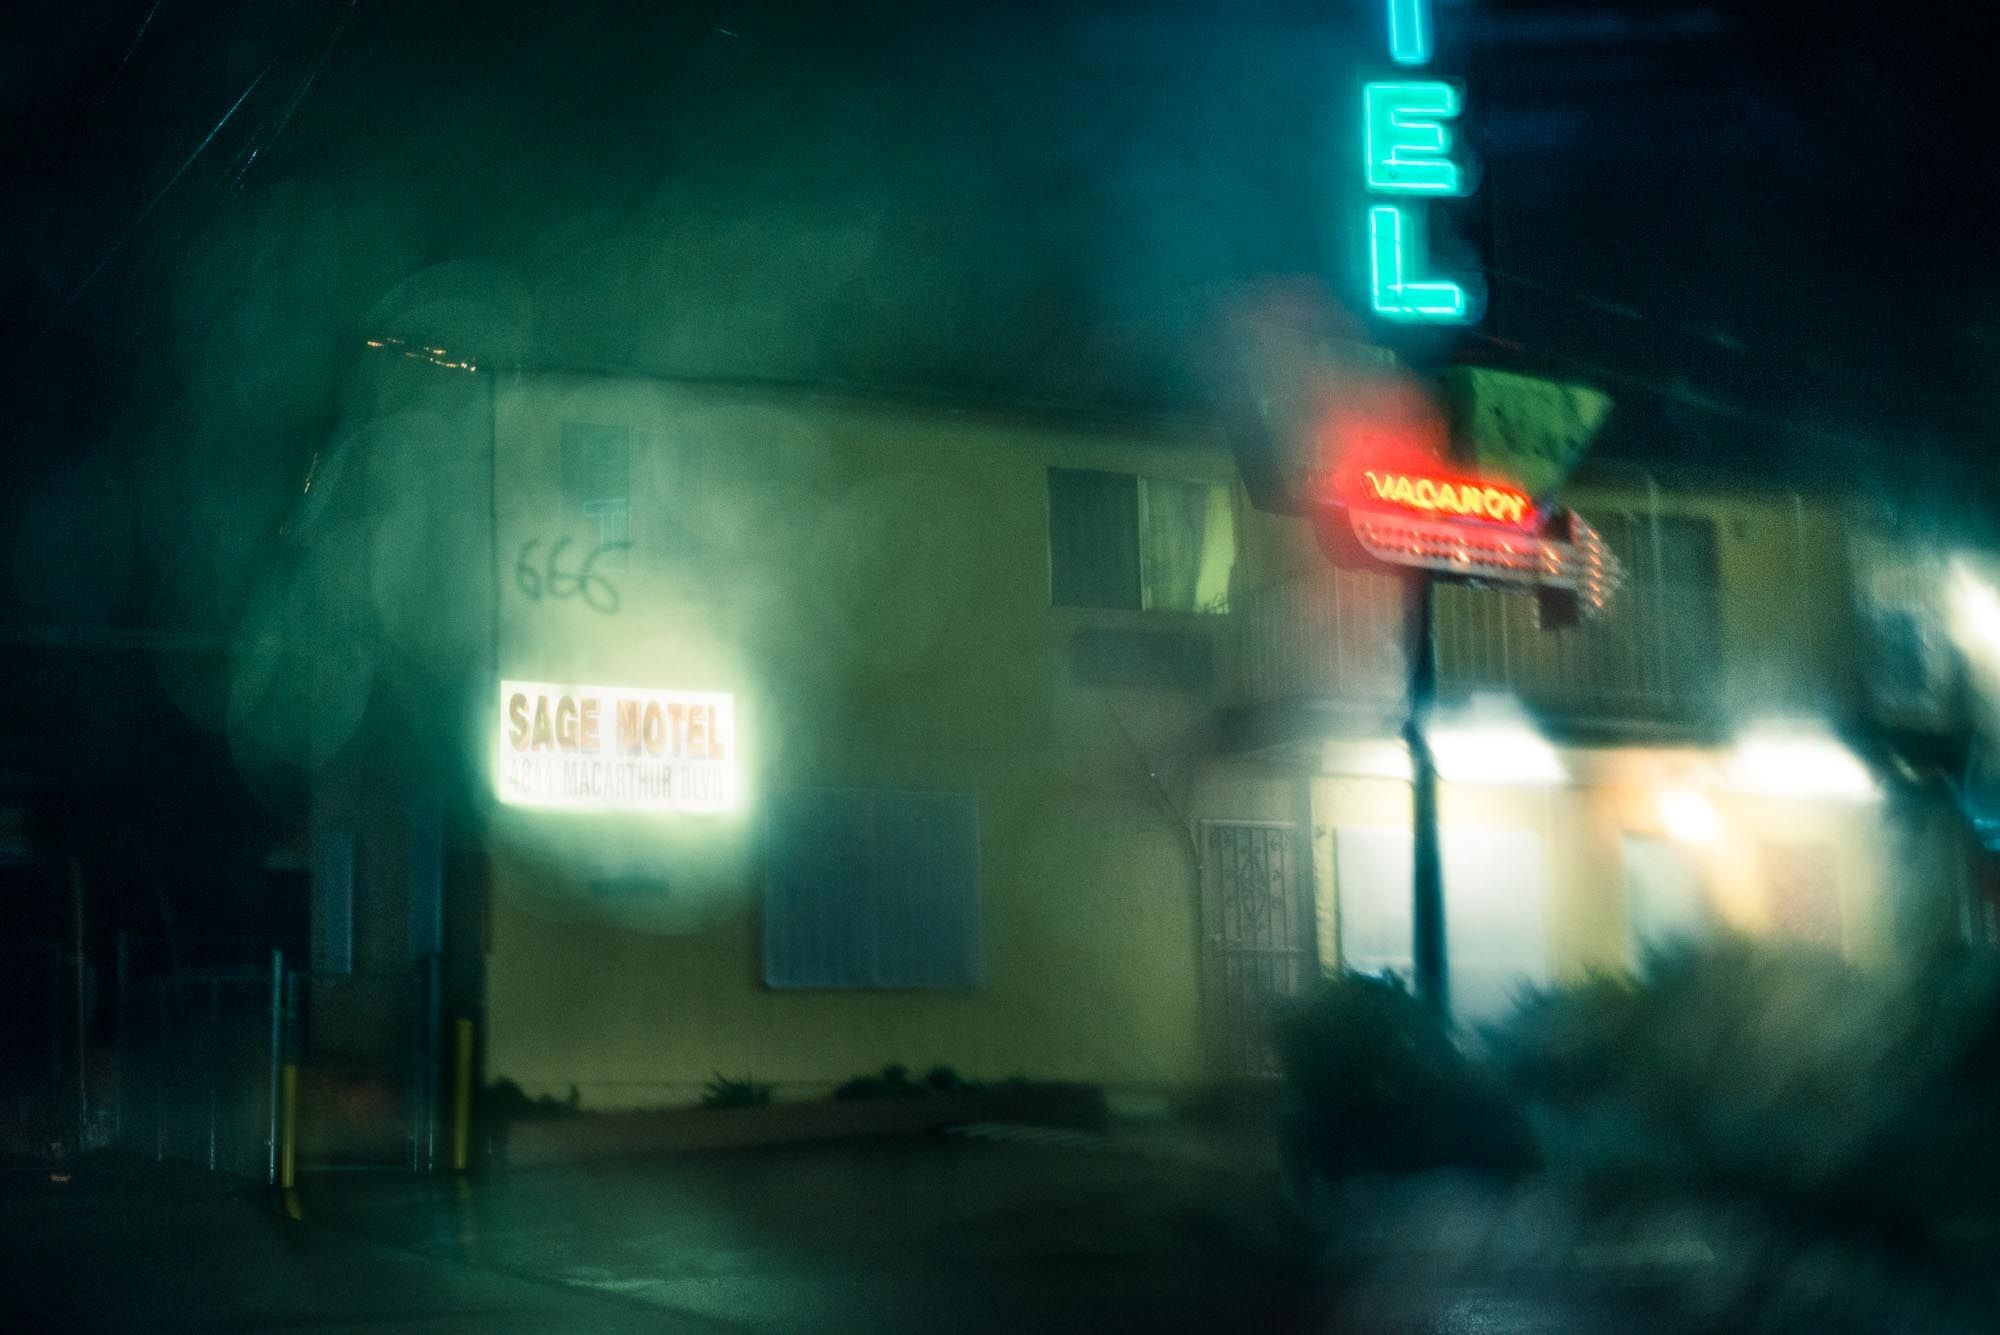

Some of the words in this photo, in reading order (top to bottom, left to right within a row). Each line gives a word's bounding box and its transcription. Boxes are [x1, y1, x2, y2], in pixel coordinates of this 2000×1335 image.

[1364, 469, 1527, 523] VACANCY
[516, 535, 634, 616] 666
[508, 693, 600, 753] SAGE
[616, 699, 724, 761] MOTEL
[563, 761, 672, 799] MACARTHUR
[681, 766, 724, 801] BLVD
